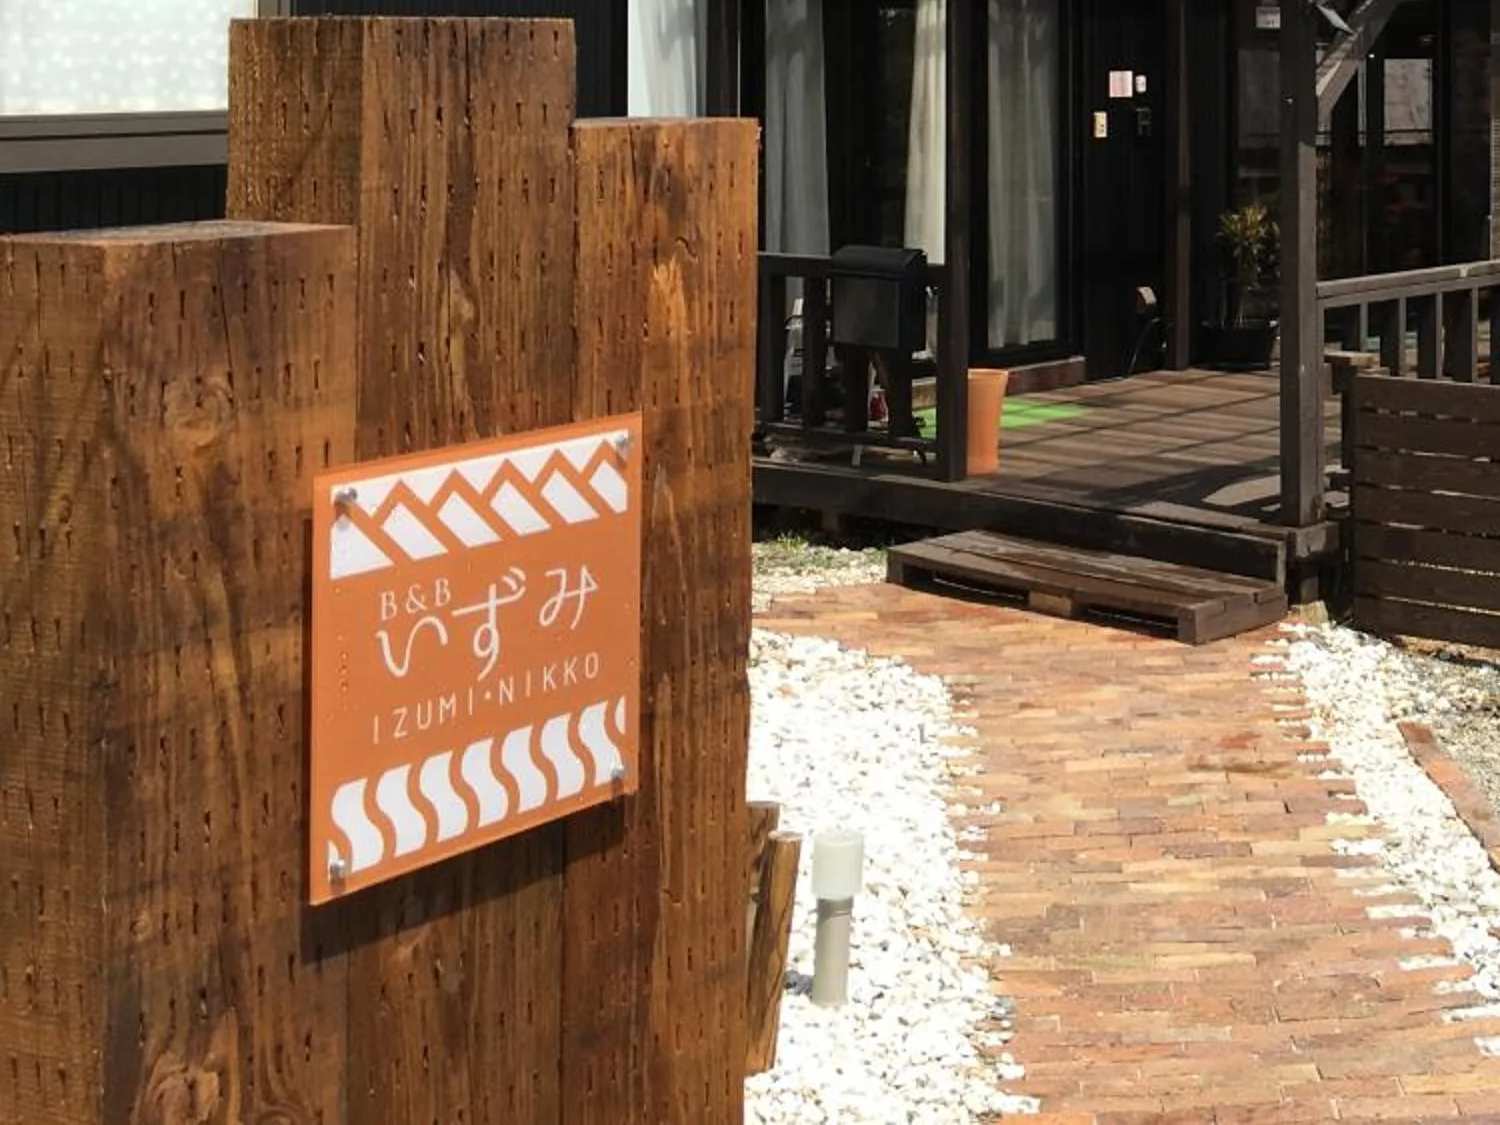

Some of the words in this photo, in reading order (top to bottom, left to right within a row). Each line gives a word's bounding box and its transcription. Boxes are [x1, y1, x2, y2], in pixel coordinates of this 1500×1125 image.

[376, 566, 599, 682] いずみ
[381, 577, 452, 621] B&B
